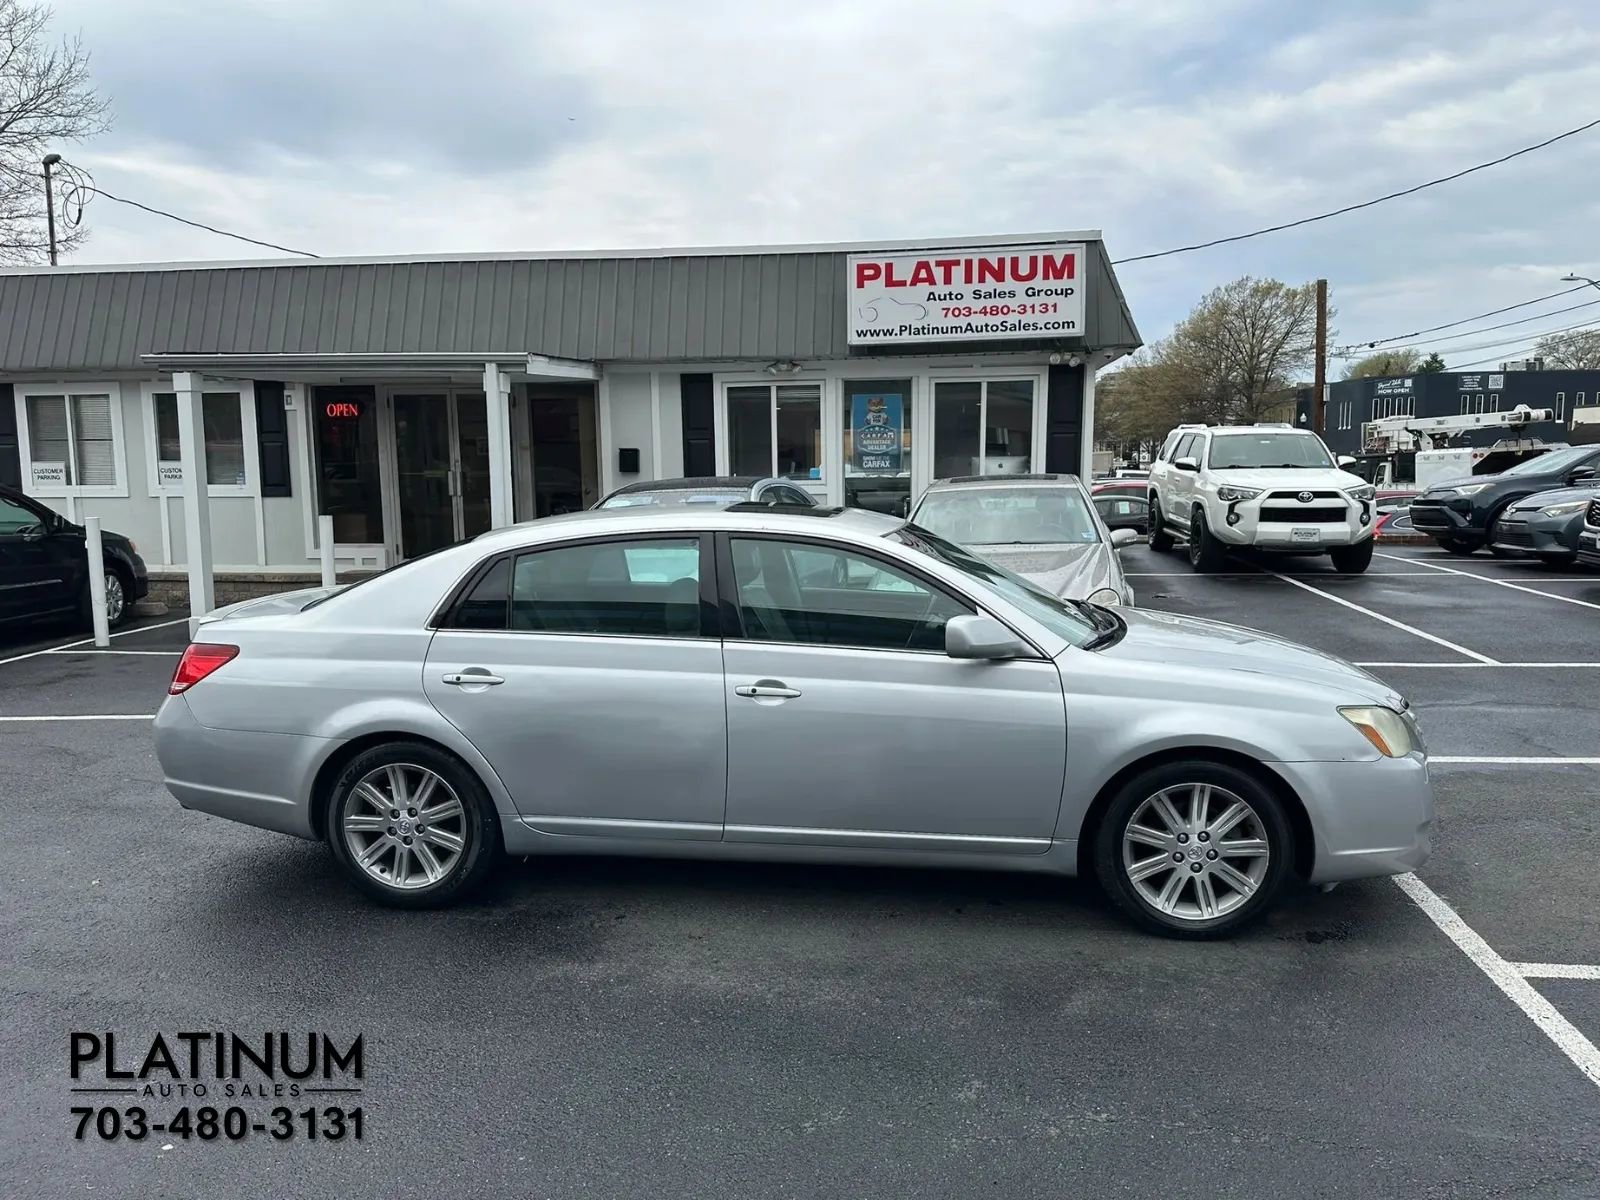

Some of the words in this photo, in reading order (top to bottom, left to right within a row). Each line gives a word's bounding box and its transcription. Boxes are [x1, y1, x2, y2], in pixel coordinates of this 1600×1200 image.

[856, 253, 1075, 289] PLATINUM
[926, 291, 964, 302] Auto
[972, 288, 1017, 300] Sales
[1025, 287, 1075, 299] Group
[941, 302, 1058, 318] 703-480-3131
[856, 320, 1076, 338] www.PlatinumAutoSales.com
[326, 403, 358, 417] OPEN
[863, 460, 890, 468] CARFAX
